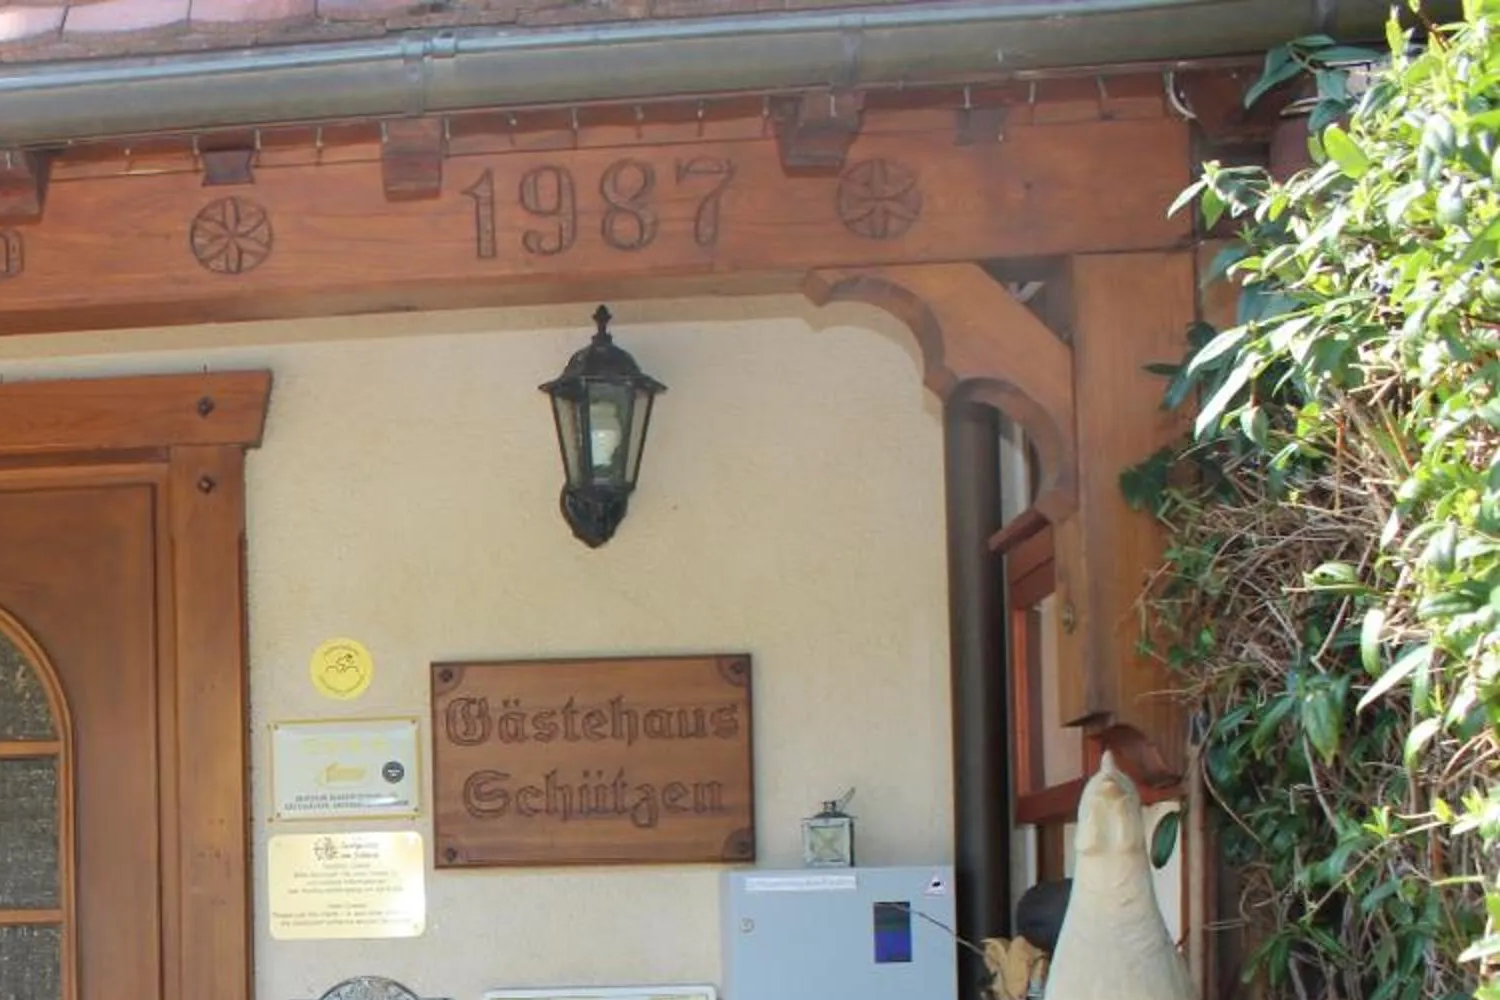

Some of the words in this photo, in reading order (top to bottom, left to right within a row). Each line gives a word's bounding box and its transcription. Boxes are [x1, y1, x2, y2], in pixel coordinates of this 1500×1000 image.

[460, 156, 736, 259] 1987
[445, 694, 740, 747] Gästehaus
[462, 766, 726, 829] Schützen
